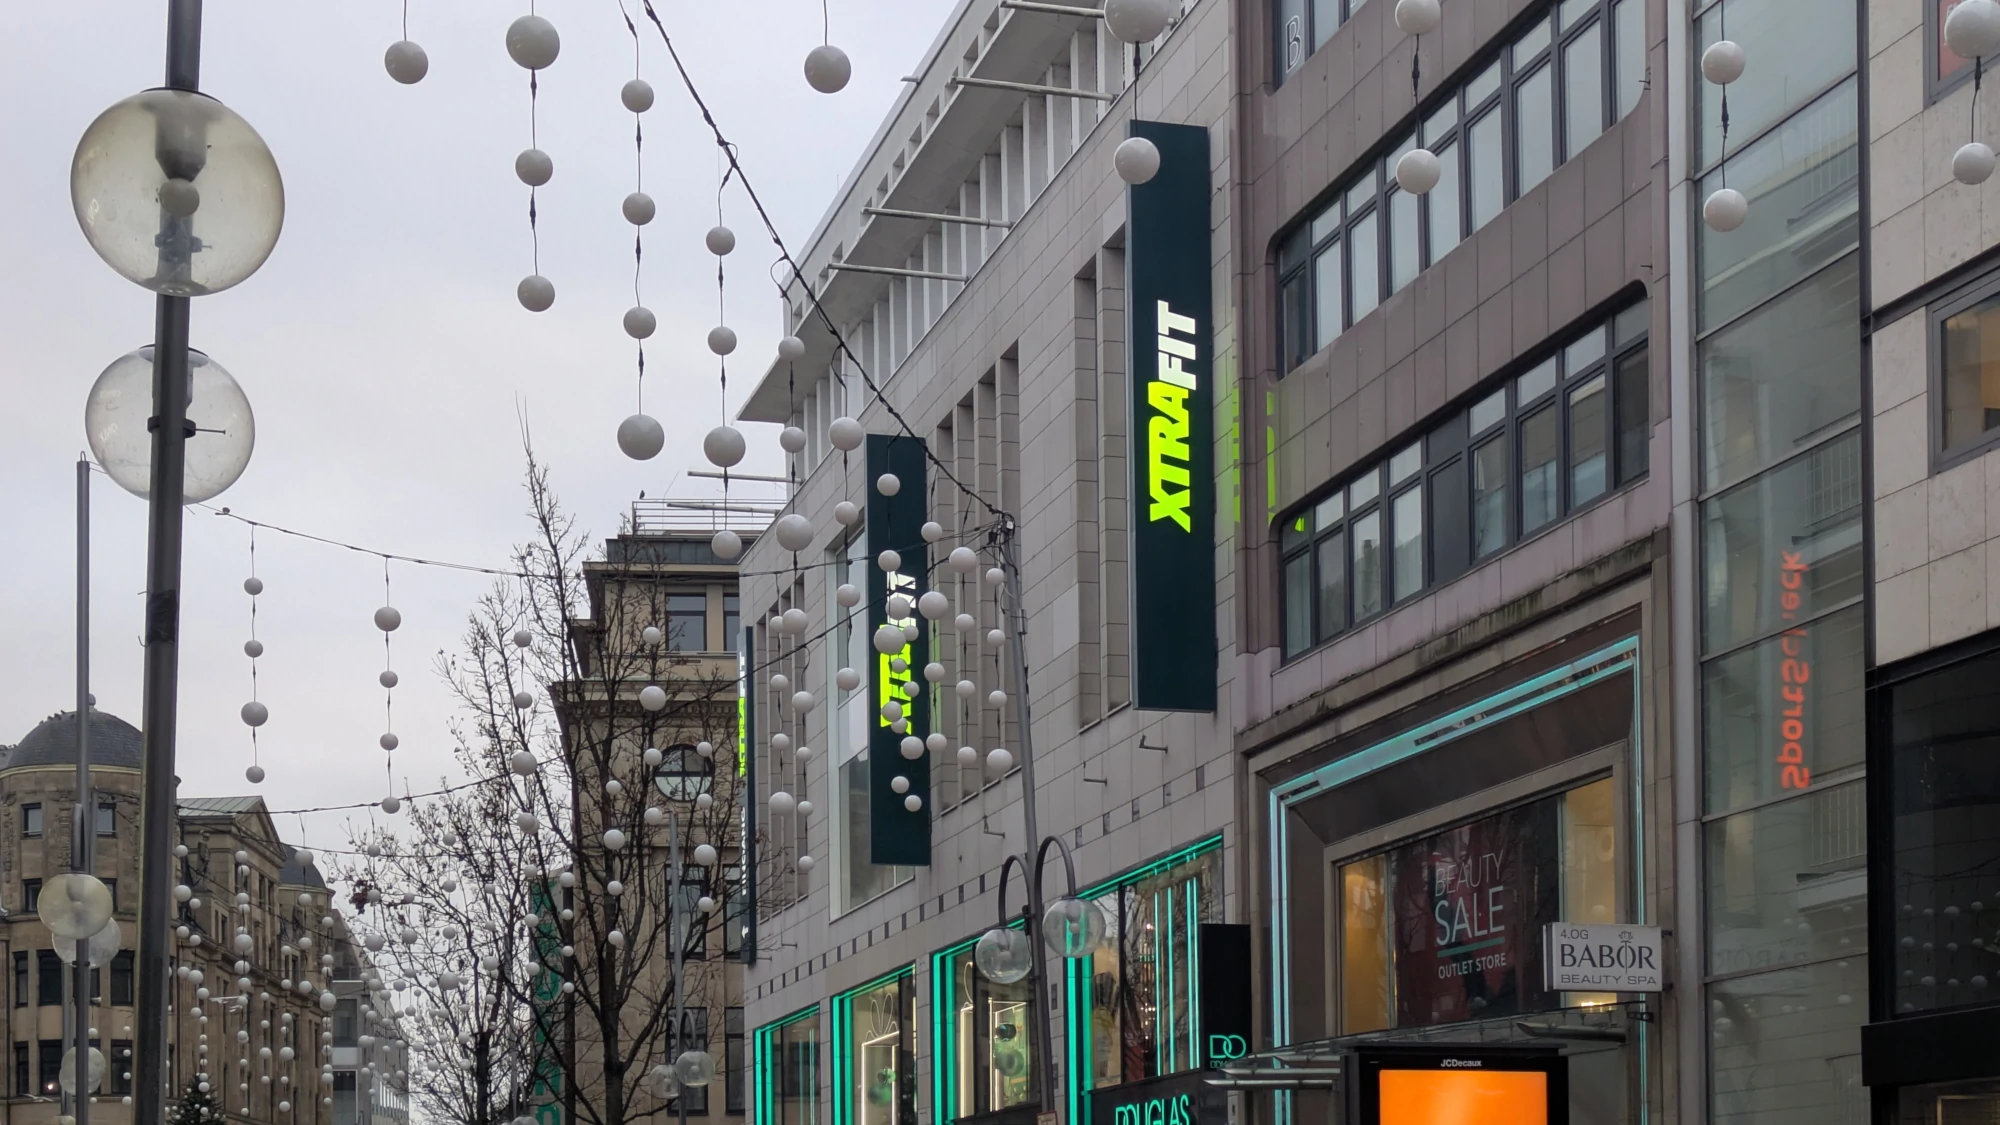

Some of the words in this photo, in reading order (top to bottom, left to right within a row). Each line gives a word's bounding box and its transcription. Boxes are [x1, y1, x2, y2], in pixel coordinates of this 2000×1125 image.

[1148, 300, 1196, 533] XTRAFIT
[1435, 849, 1504, 897] BEAUTY
[1435, 885, 1505, 946] SALE
[1560, 929, 1589, 939] 4.OG
[1438, 960, 1473, 979] OUTLET
[1475, 952, 1507, 972] STORE
[1561, 943, 1656, 970] BABOR
[1561, 974, 1621, 984] BEAUTY
[1627, 975, 1657, 985] SPA
[1440, 1059, 1482, 1067] JCDecaux
